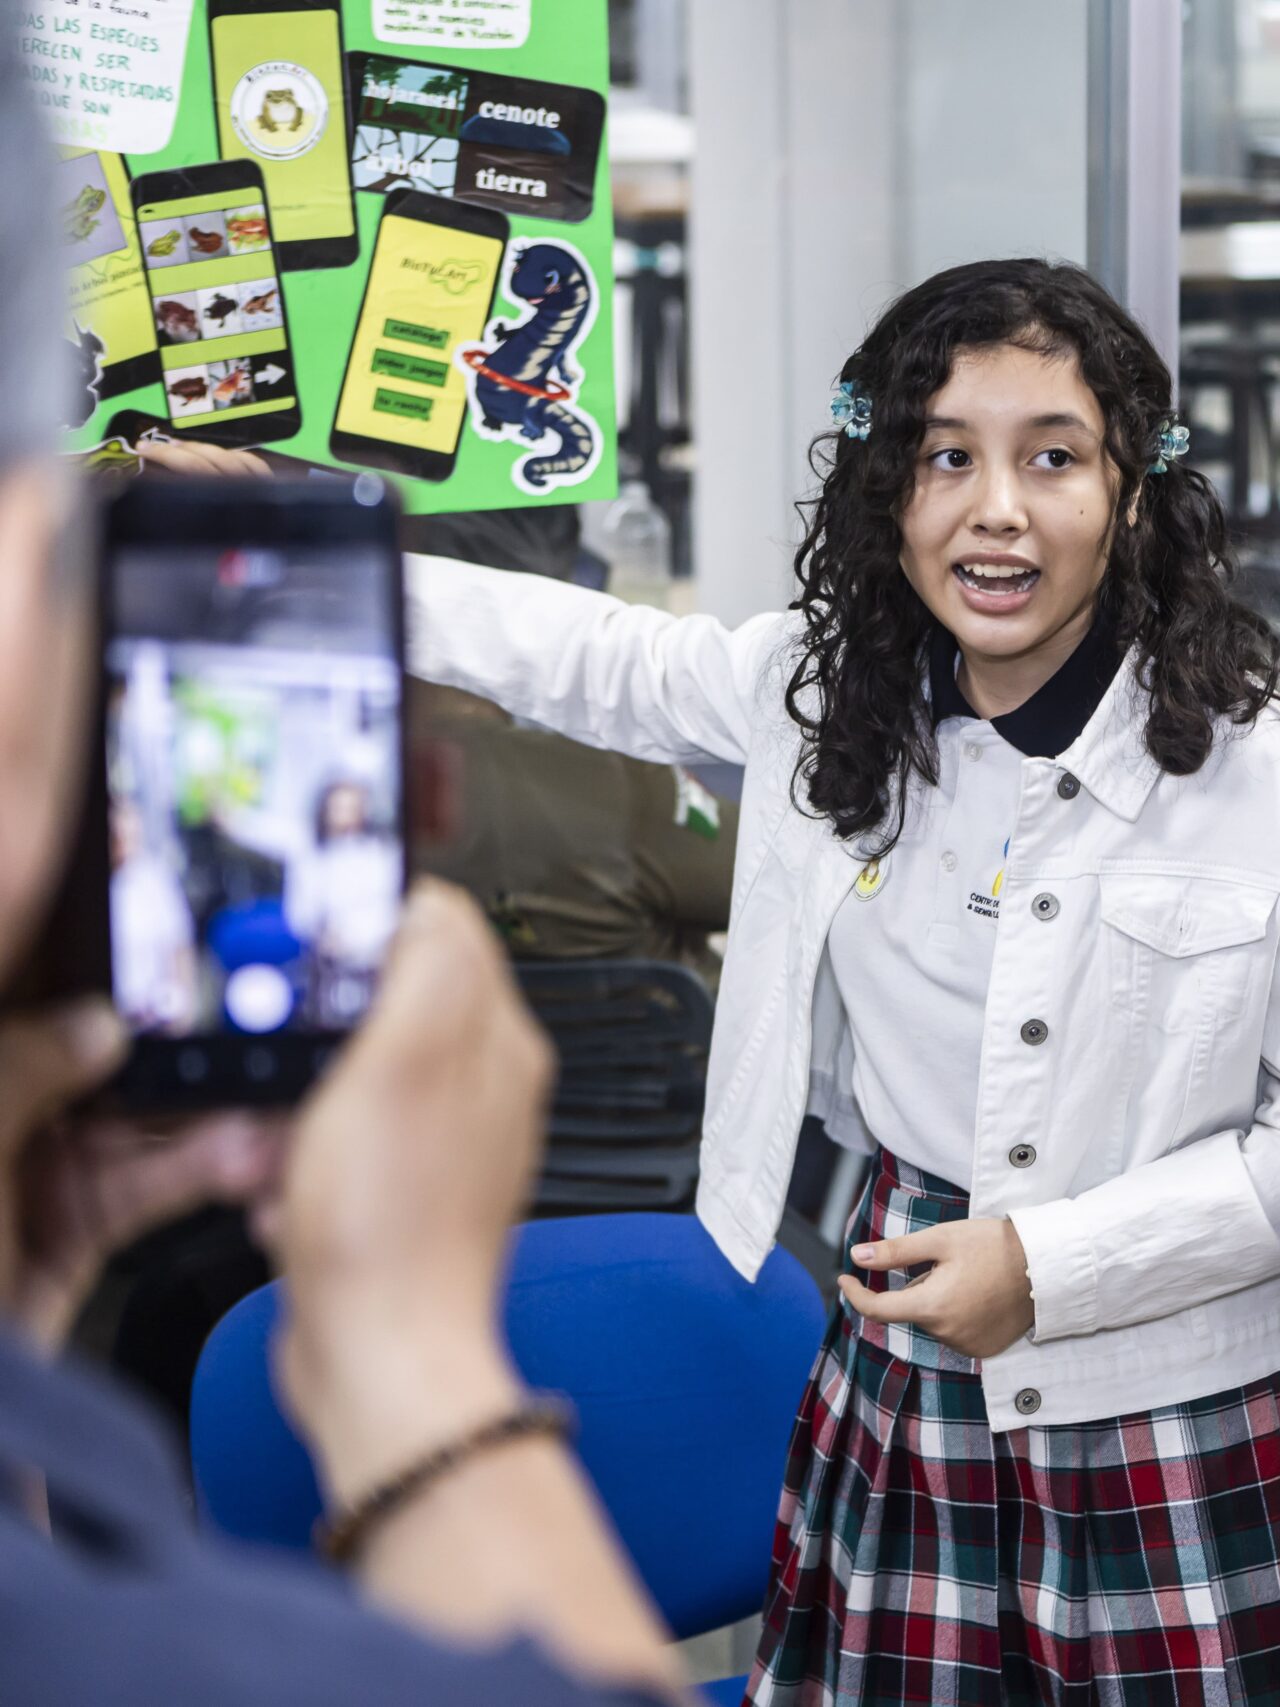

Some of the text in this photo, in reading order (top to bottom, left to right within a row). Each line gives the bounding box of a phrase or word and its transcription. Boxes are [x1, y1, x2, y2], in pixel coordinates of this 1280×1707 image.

[54, 15, 81, 34] LAS
[90, 23, 160, 53] ESPECIES
[95, 53, 131, 72] SER
[79, 72, 175, 102] RESPETADAS
[82, 99, 112, 116] SON
[478, 100, 561, 129] cenote
[475, 168, 548, 198] tierra
[970, 892, 993, 906] CENTR
